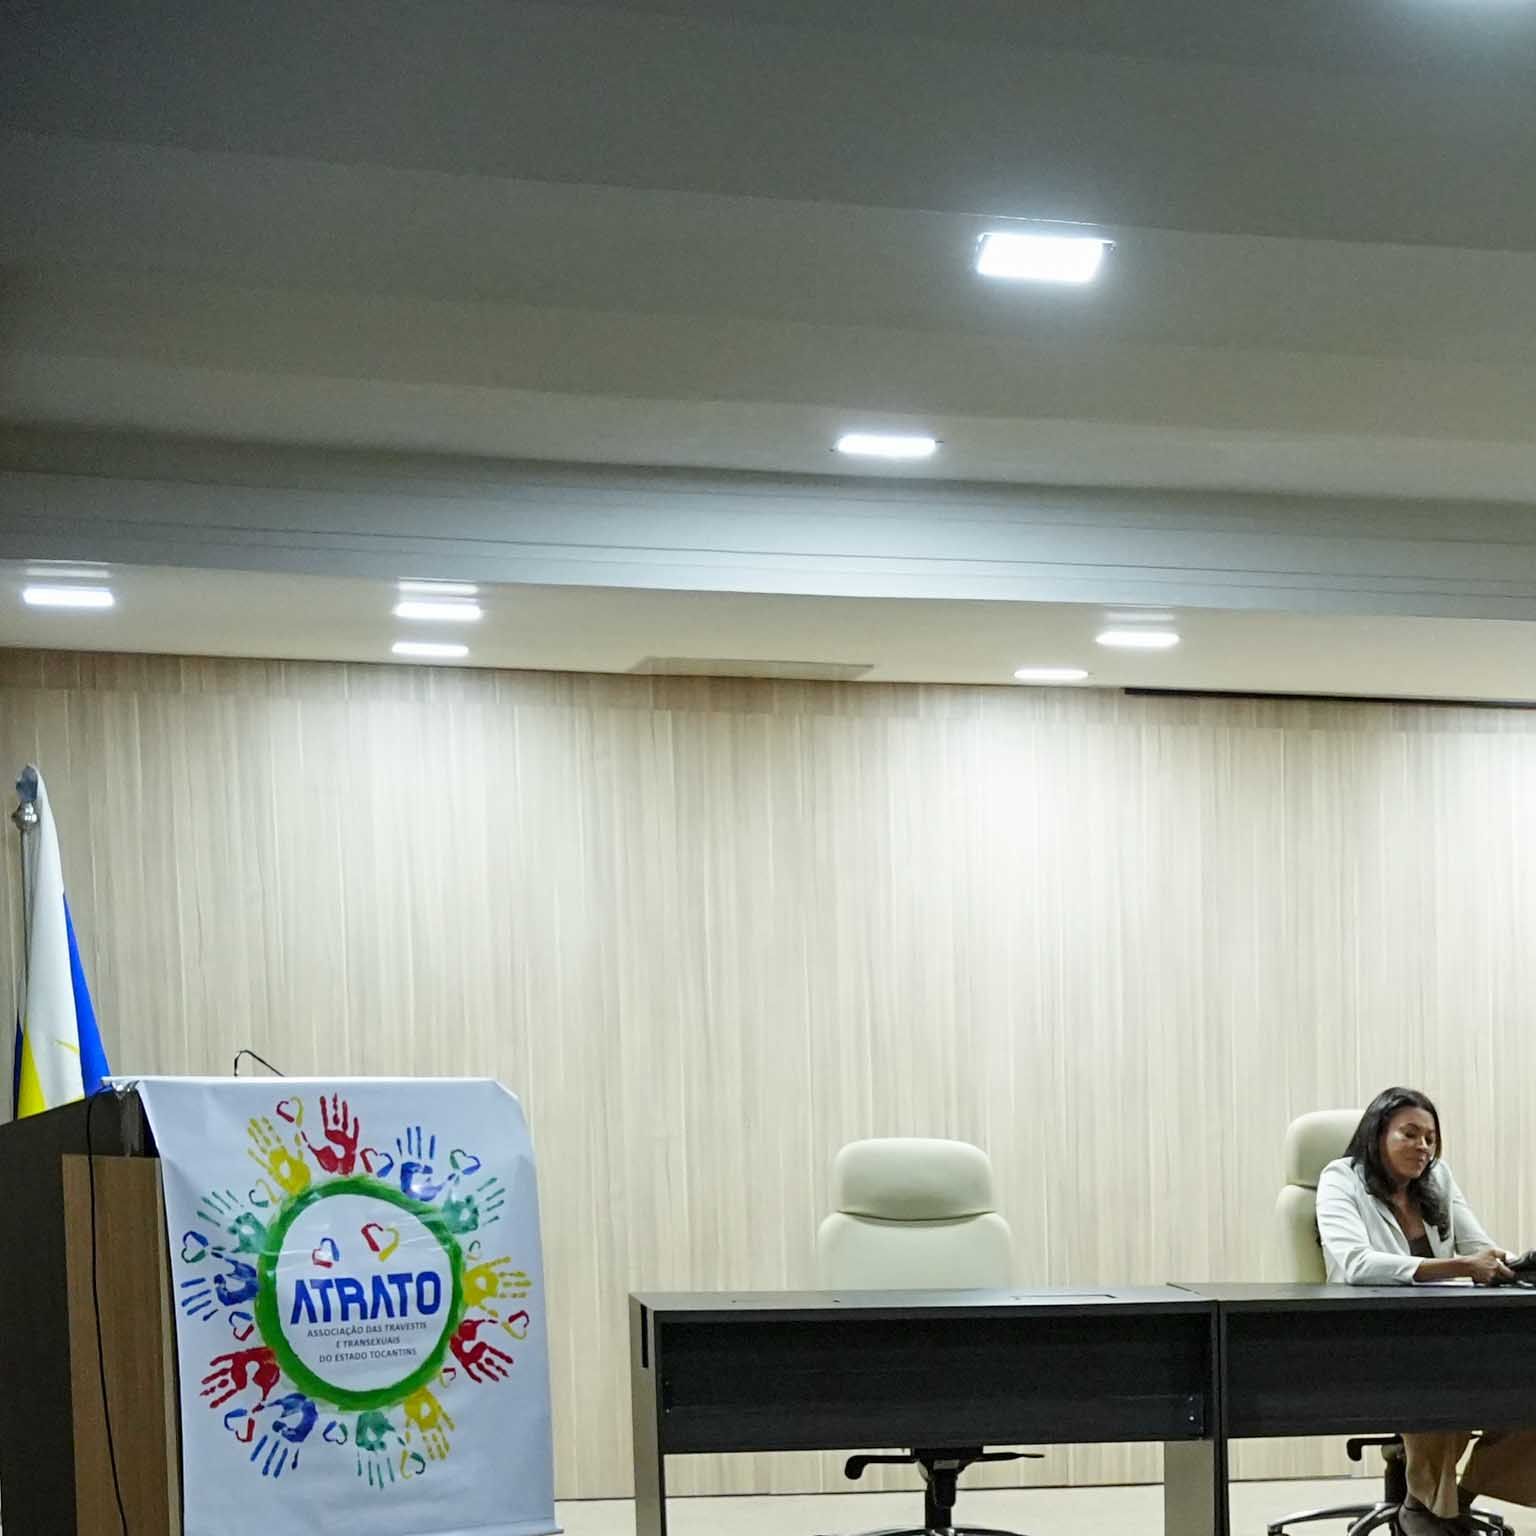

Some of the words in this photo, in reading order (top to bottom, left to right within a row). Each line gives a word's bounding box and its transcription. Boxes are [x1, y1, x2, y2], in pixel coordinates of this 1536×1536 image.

[290, 1271, 441, 1324] ATRATO
[307, 1324, 364, 1337] ASSOCIAÇÃO
[366, 1325, 382, 1334] DAS
[385, 1321, 427, 1332] TRAVESTIS
[335, 1340, 341, 1348] E
[343, 1336, 401, 1348] TRANSEXUAIS
[319, 1353, 333, 1363] DO
[334, 1351, 368, 1362] ESTADO
[370, 1348, 417, 1360] TOCANTINS
